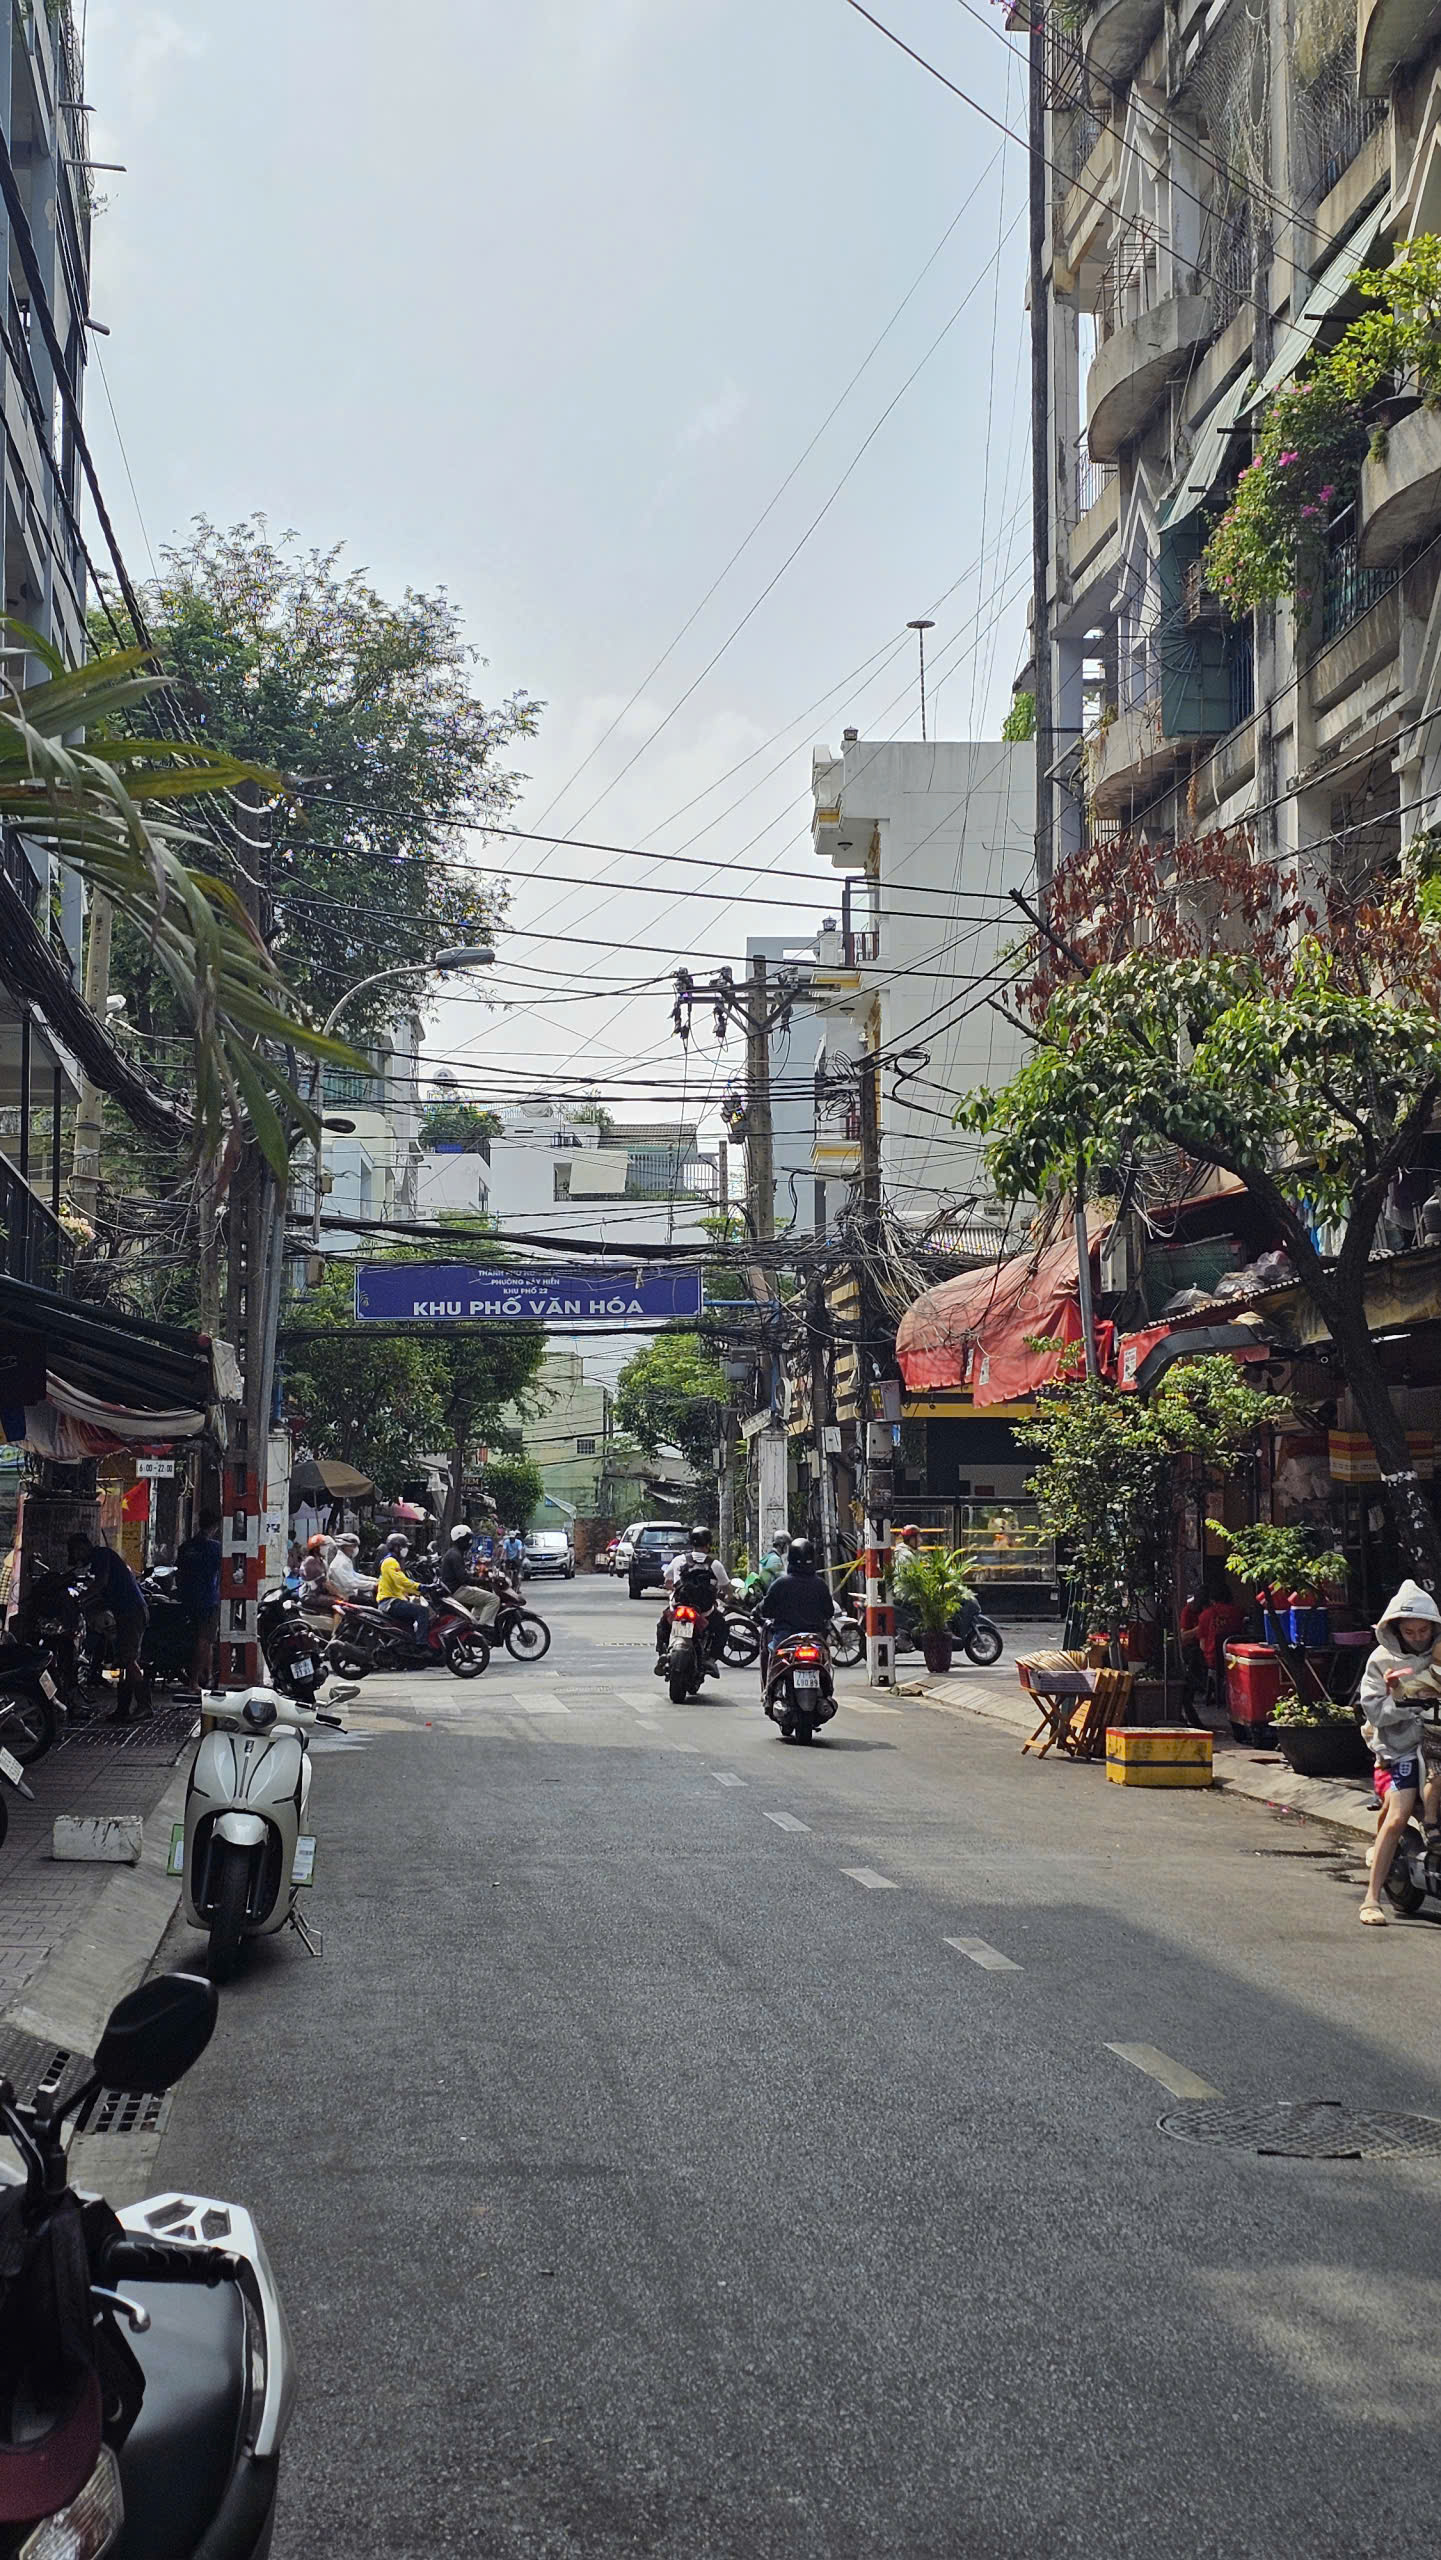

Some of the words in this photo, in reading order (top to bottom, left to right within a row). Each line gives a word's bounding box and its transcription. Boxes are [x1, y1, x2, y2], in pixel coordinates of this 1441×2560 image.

[520, 1285, 538, 1294] PHỐ
[413, 1301, 462, 1316] KHU
[469, 1295, 522, 1315] PHỐ
[529, 1297, 581, 1314] VĂN
[589, 1296, 644, 1314] HÓA
